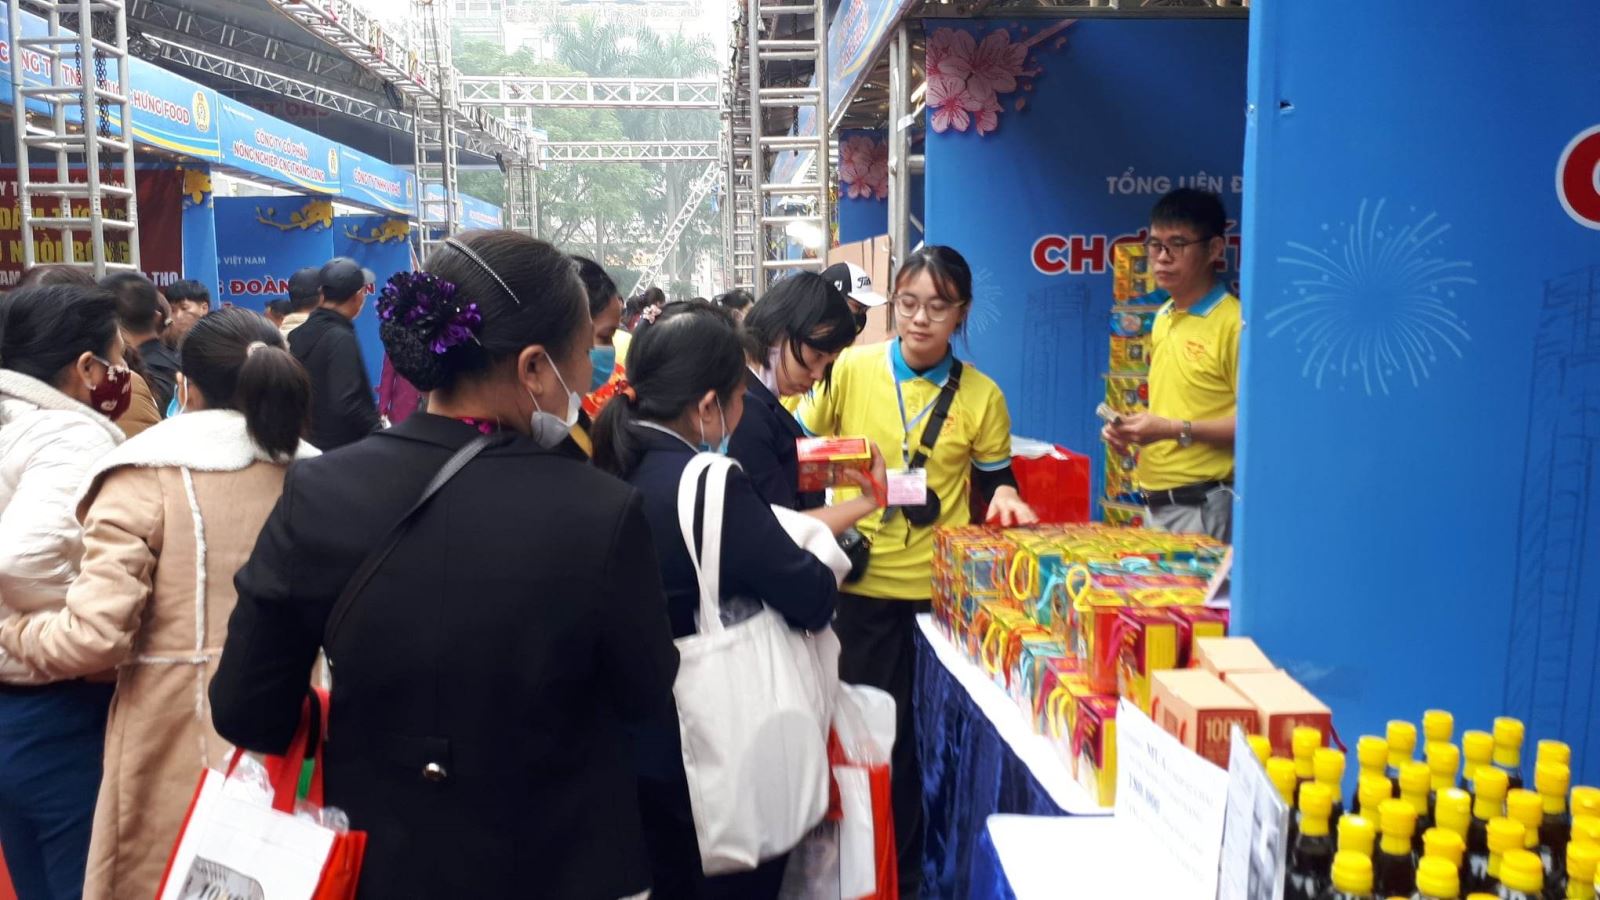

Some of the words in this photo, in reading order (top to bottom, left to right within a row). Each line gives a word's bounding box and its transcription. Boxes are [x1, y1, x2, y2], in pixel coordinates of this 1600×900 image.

[0, 40, 40, 74] CNG
[163, 102, 191, 125] FOOD
[1107, 167, 1171, 195] TỔNG
[244, 256, 266, 266] NAM
